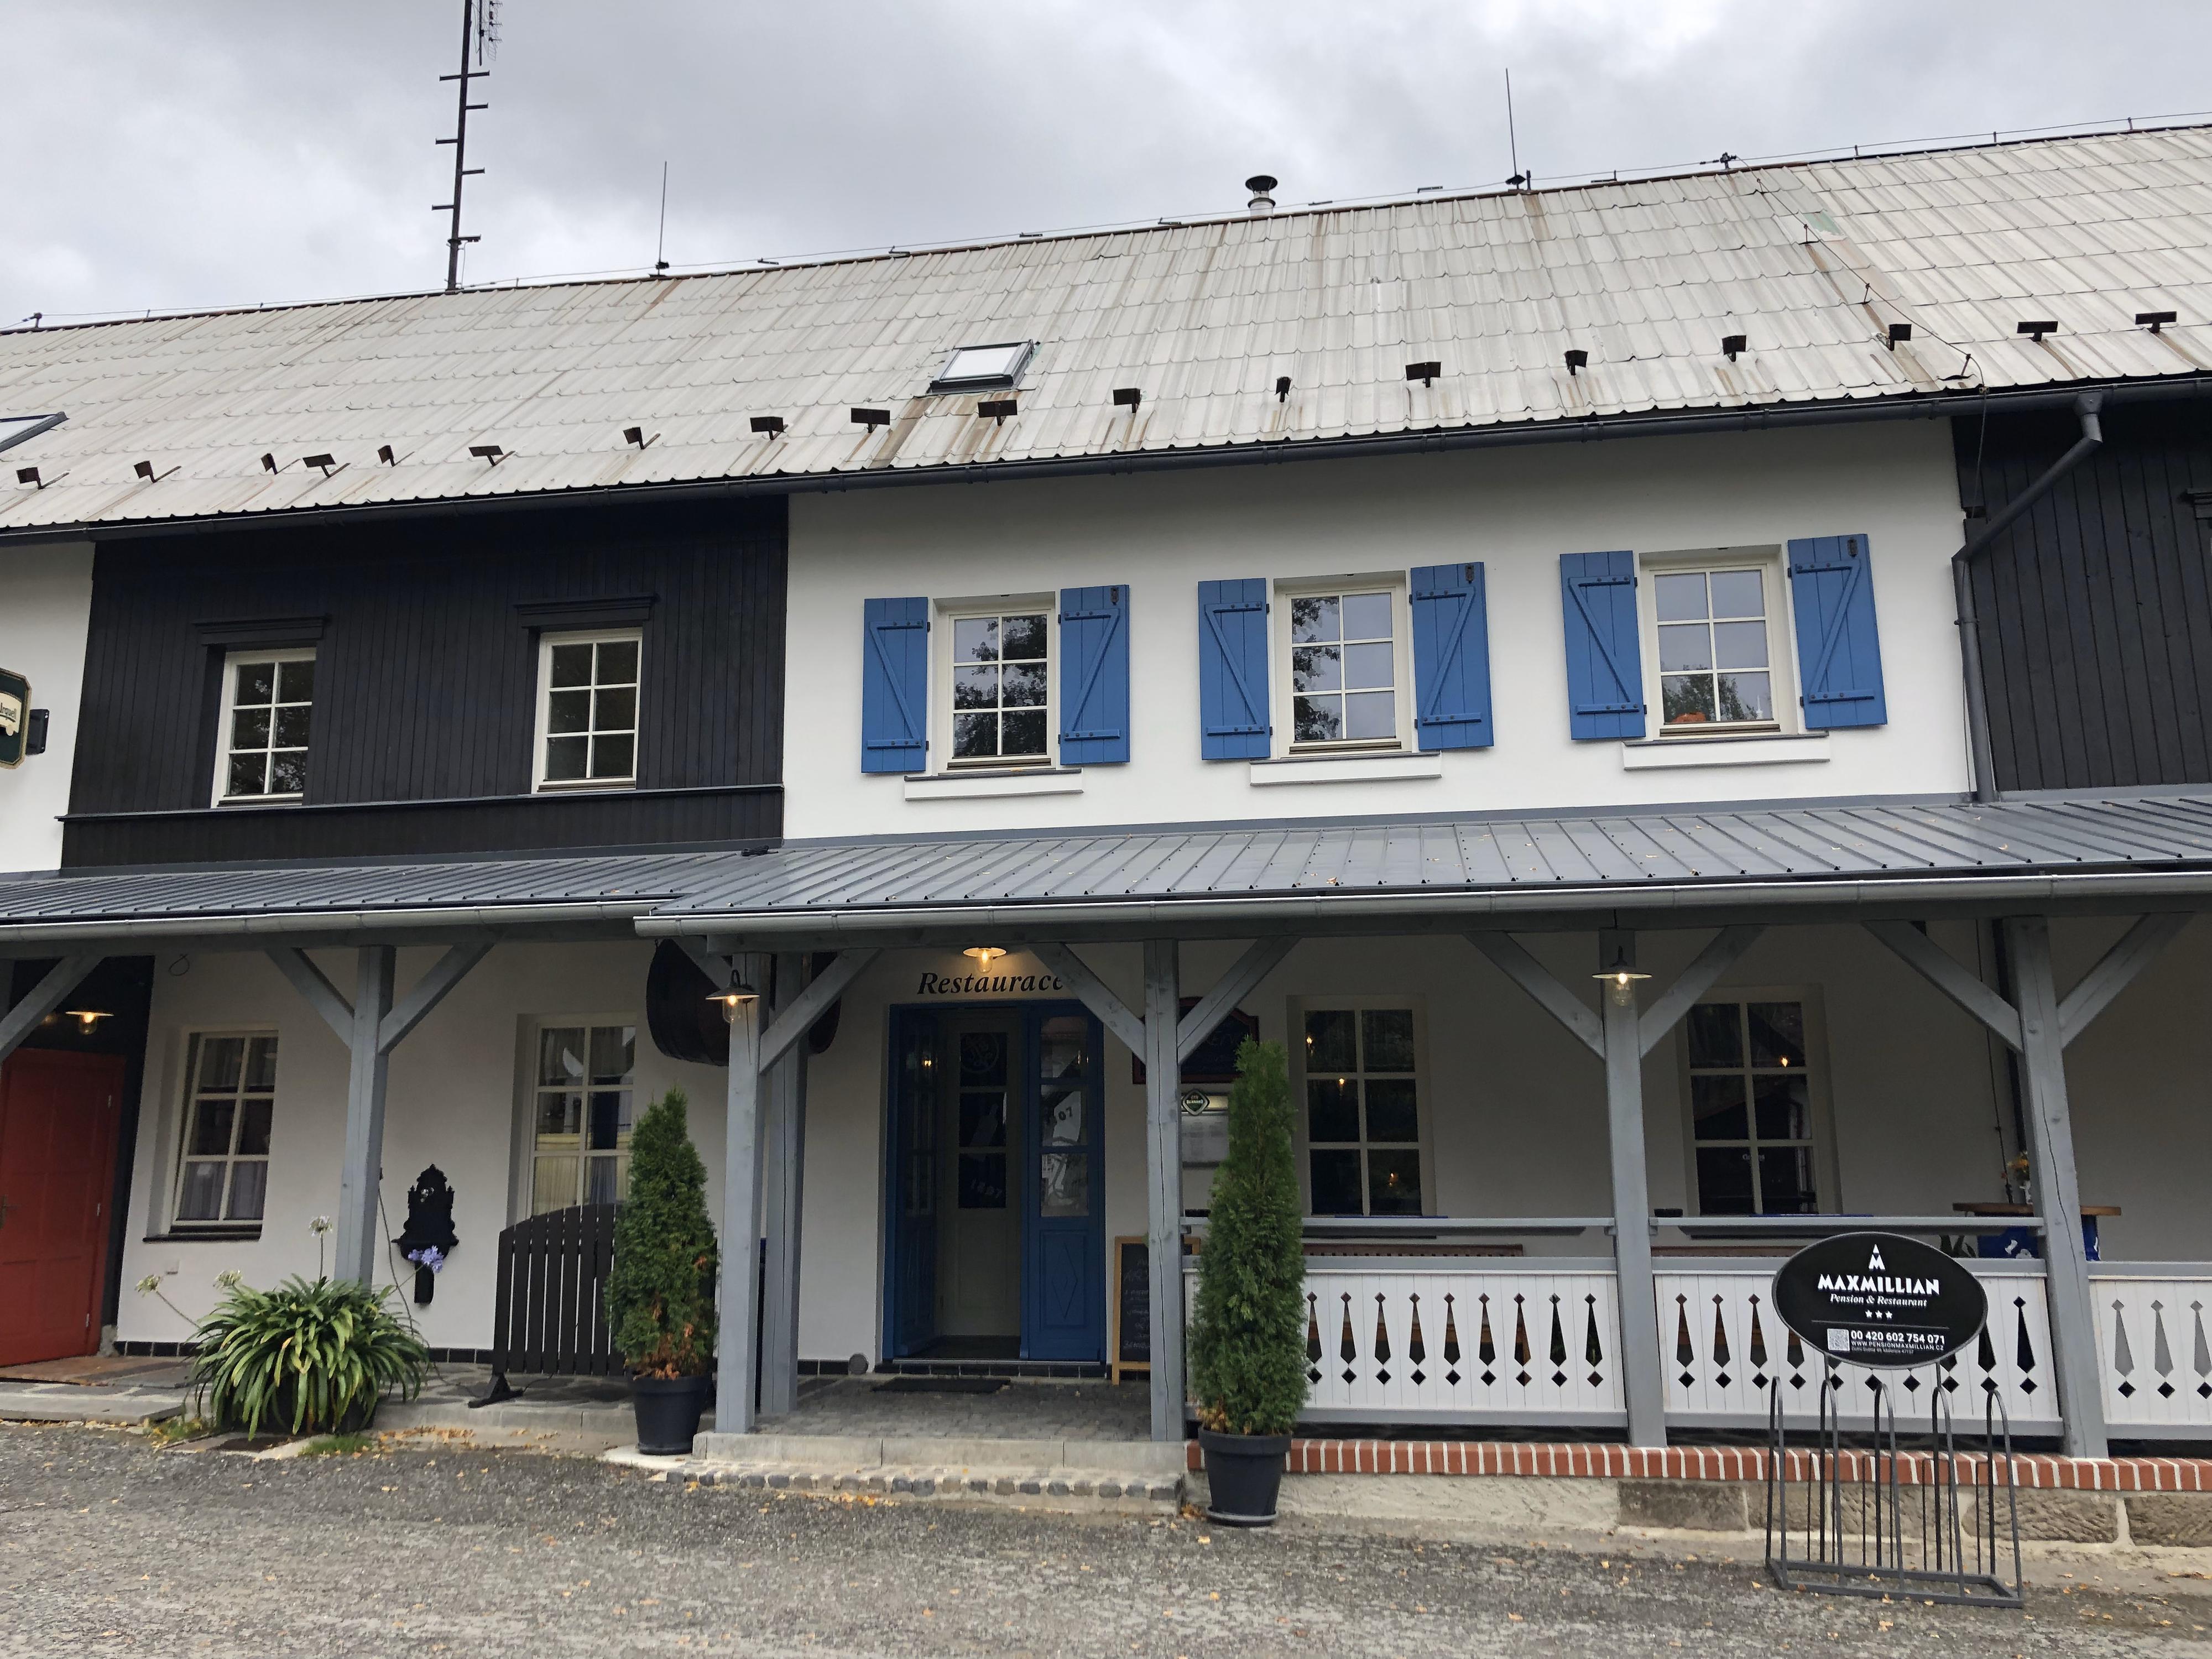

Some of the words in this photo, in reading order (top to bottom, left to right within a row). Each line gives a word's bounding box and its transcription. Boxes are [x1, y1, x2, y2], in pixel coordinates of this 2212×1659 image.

[1817, 1274, 1940, 1295] MAXMILLIAN
[1830, 1293, 1864, 1304] Pension
[1866, 1295, 1875, 1305] &
[1877, 1295, 1927, 1307] Restaurant
[1850, 1330, 1863, 1340] 00
[1865, 1331, 1884, 1341] 420
[1886, 1332, 1905, 1342] 602
[1906, 1333, 1926, 1343] 754
[1927, 1334, 1945, 1344] 071
